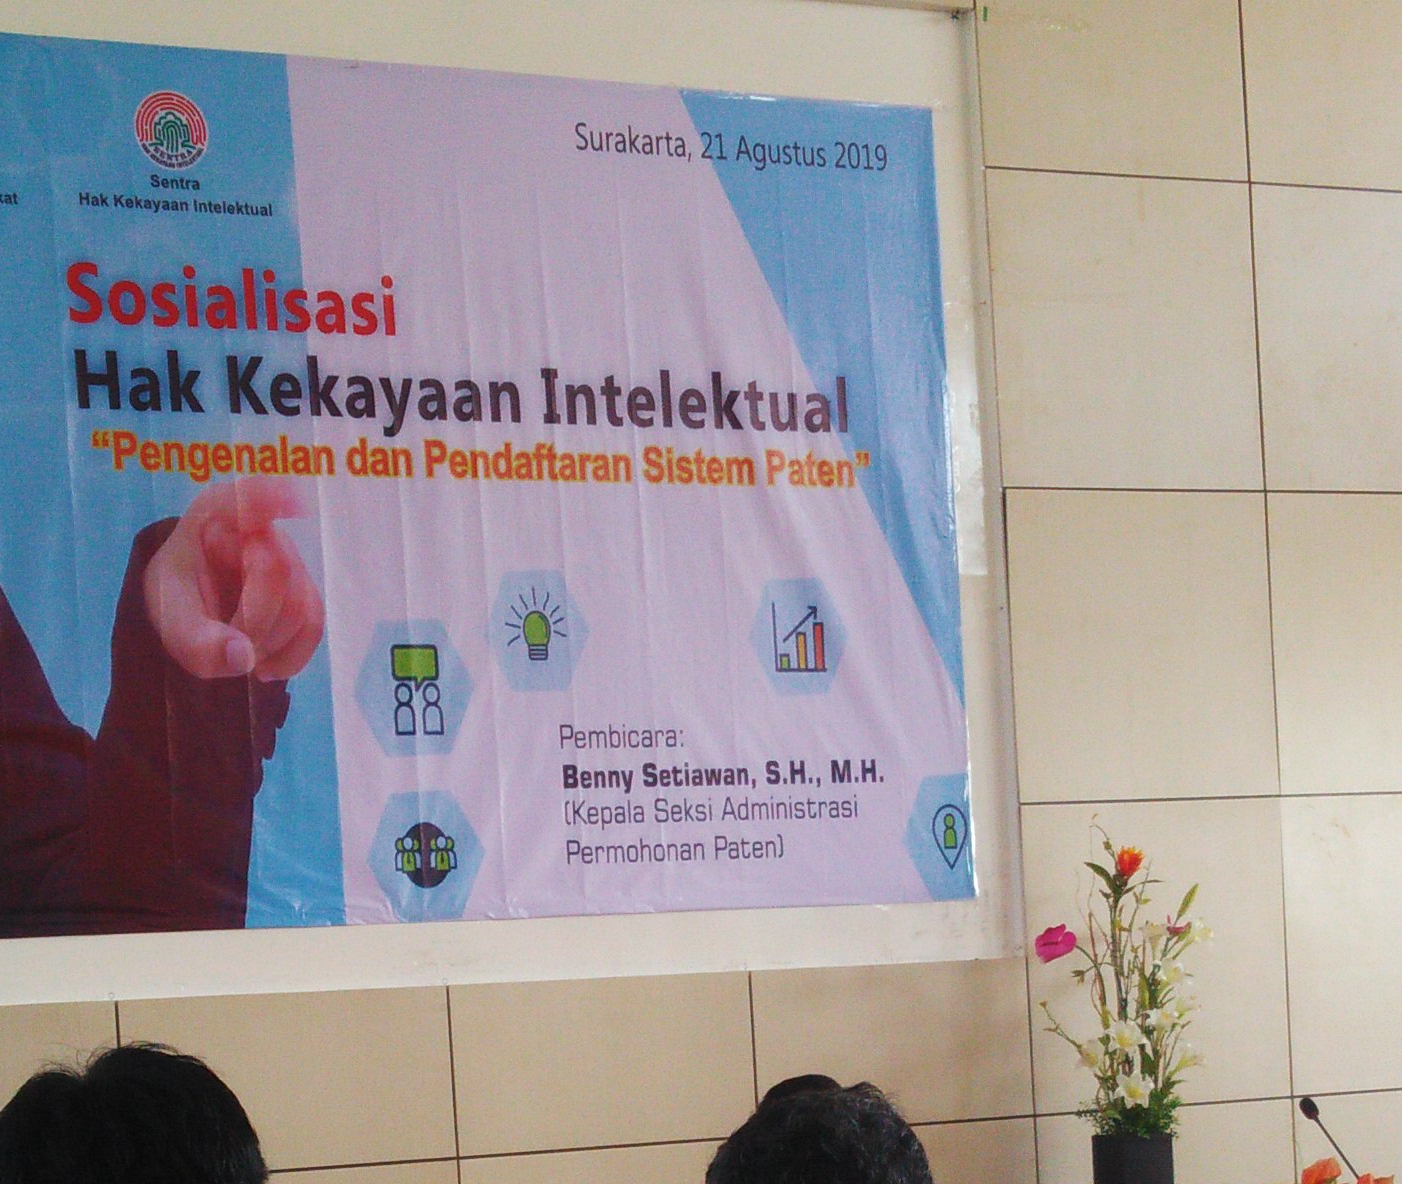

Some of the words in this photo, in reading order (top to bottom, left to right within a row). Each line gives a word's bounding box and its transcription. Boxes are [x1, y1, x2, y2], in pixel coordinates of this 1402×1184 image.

[574, 122, 692, 162] Surakarta,
[700, 131, 728, 161] 21
[736, 135, 827, 171] Agustus
[834, 141, 888, 171] 2019
[149, 174, 201, 191] Sentra
[78, 192, 109, 207] Hak
[113, 194, 189, 213] Kekayaan
[193, 199, 273, 217] Intelektual
[65, 261, 397, 336] Sosialisasi
[73, 348, 206, 414] Hak
[225, 355, 522, 438] Kekayaan
[540, 366, 850, 434] Intelektual
[346, 435, 414, 478] dan
[422, 438, 633, 484] Pendaftaran
[641, 445, 757, 488] Sistem
[559, 723, 685, 750] Pembicara:
[562, 763, 634, 794] Benny
[642, 762, 758, 790] Setiawan,
[765, 760, 822, 788] S.H.,
[830, 759, 885, 784] M.H.
[564, 799, 645, 831] (Kepala
[654, 797, 714, 823] Seksi
[721, 794, 859, 822] Administrasi
[566, 837, 706, 865] Permohonan
[714, 833, 785, 861] Paten)
